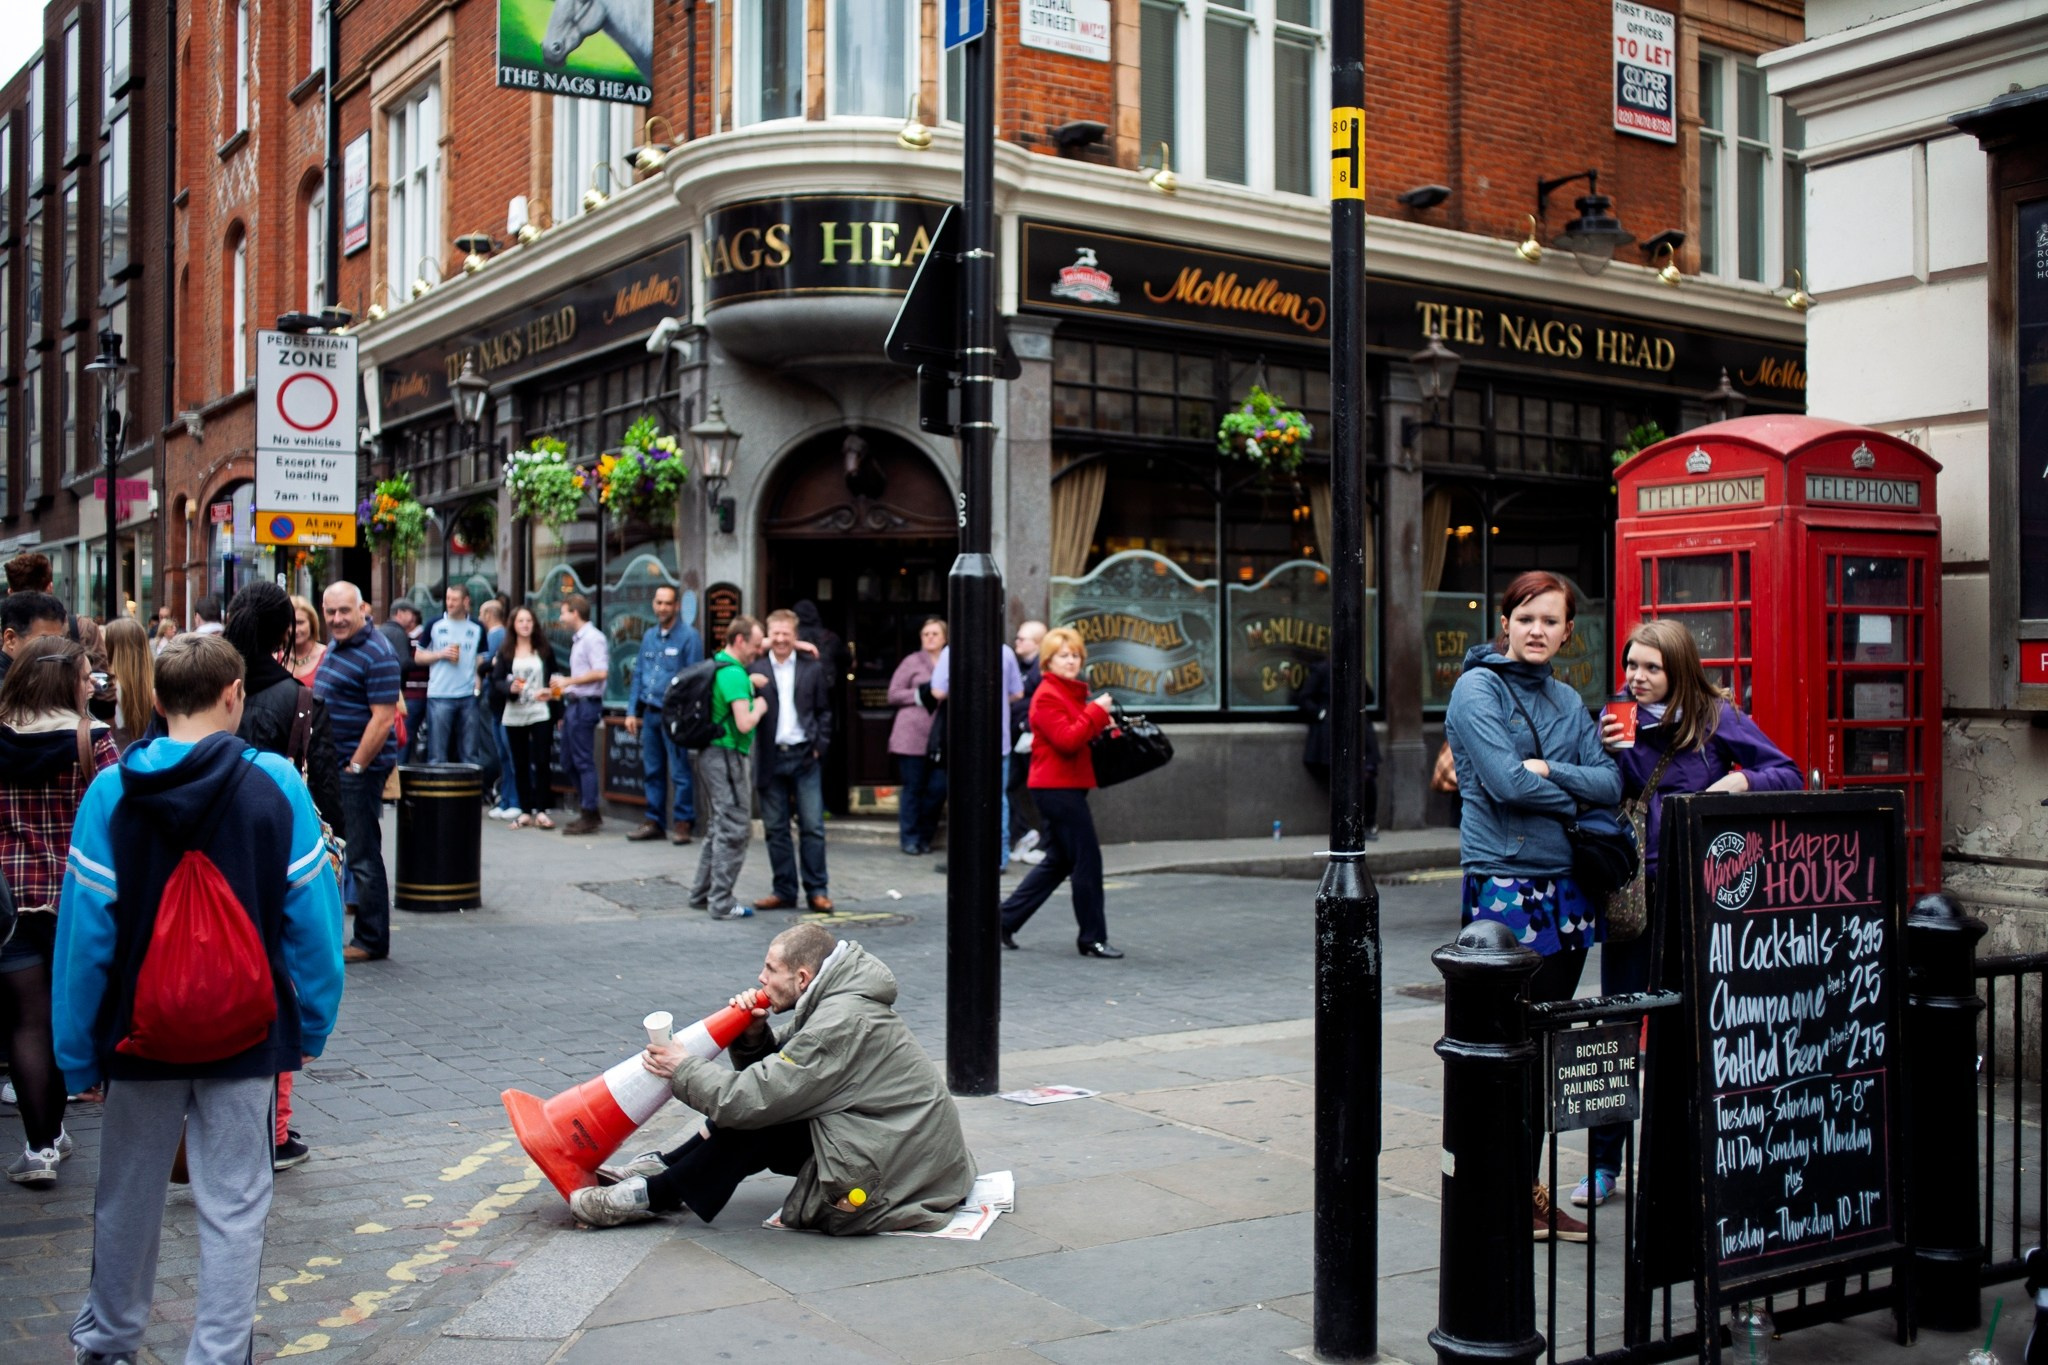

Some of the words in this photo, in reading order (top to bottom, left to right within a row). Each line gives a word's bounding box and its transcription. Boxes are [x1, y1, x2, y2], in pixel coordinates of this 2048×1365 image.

[1031, 10, 1076, 32] STREET
[1615, 2, 1641, 17] FIRST
[1644, 9, 1673, 27] FLOOR
[1627, 21, 1664, 41] OFFICES
[1617, 37, 1638, 58] TO
[1645, 44, 1672, 67] LET
[501, 65, 540, 87] THE
[543, 72, 595, 95] NAGS
[599, 80, 652, 102] HEAD
[1623, 65, 1667, 93] COOPER
[1623, 83, 1668, 111] COLLINS
[820, 220, 932, 268] HEA
[1144, 266, 1326, 332] McMullen
[267, 335, 349, 350] PEDESTRIAN
[479, 325, 522, 373] NAGS
[527, 305, 577, 355] HEAD
[1416, 301, 1485, 345] THE
[1499, 312, 1583, 359] NAGS
[1596, 327, 1675, 373] HEAD
[278, 350, 337, 368] ZONE
[1739, 356, 1806, 390] McMu
[273, 434, 289, 445] No
[294, 436, 341, 448] vehicles
[276, 456, 316, 469] Except
[321, 457, 337, 468] for
[285, 469, 329, 482] loading
[274, 490, 298, 501] 7am
[312, 491, 339, 502] 11am
[1643, 478, 1763, 509] TELEPHONE
[1807, 477, 1915, 505] TELEPHONE
[305, 517, 318, 528] At
[323, 519, 343, 529] any
[1436, 631, 1468, 657] EST
[1770, 819, 1860, 874] Happy
[1717, 888, 1734, 905] BAR
[1739, 866, 1753, 898] GRILL
[1709, 922, 1733, 974] All
[1740, 912, 1838, 970] Cocktails
[1710, 979, 1826, 1037] Champagne
[1576, 1041, 1619, 1058] BICYCLES
[1713, 1030, 1780, 1088] Bottled
[1782, 1026, 1830, 1077] Beer
[1558, 1062, 1598, 1080] CHAINED
[1603, 1060, 1614, 1073] TO
[1619, 1057, 1636, 1071] THE
[1563, 1078, 1605, 1096] RAILINGS
[1609, 1075, 1630, 1089] WILL
[1568, 1100, 1581, 1115] BE
[1585, 1094, 1626, 1112] REMOVED
[1717, 1137, 1736, 1174] All
[1738, 1136, 1763, 1174] Day
[1766, 1126, 1809, 1166] Sunday
[1824, 1119, 1872, 1155] Monday
[1785, 1166, 1804, 1198] plus
